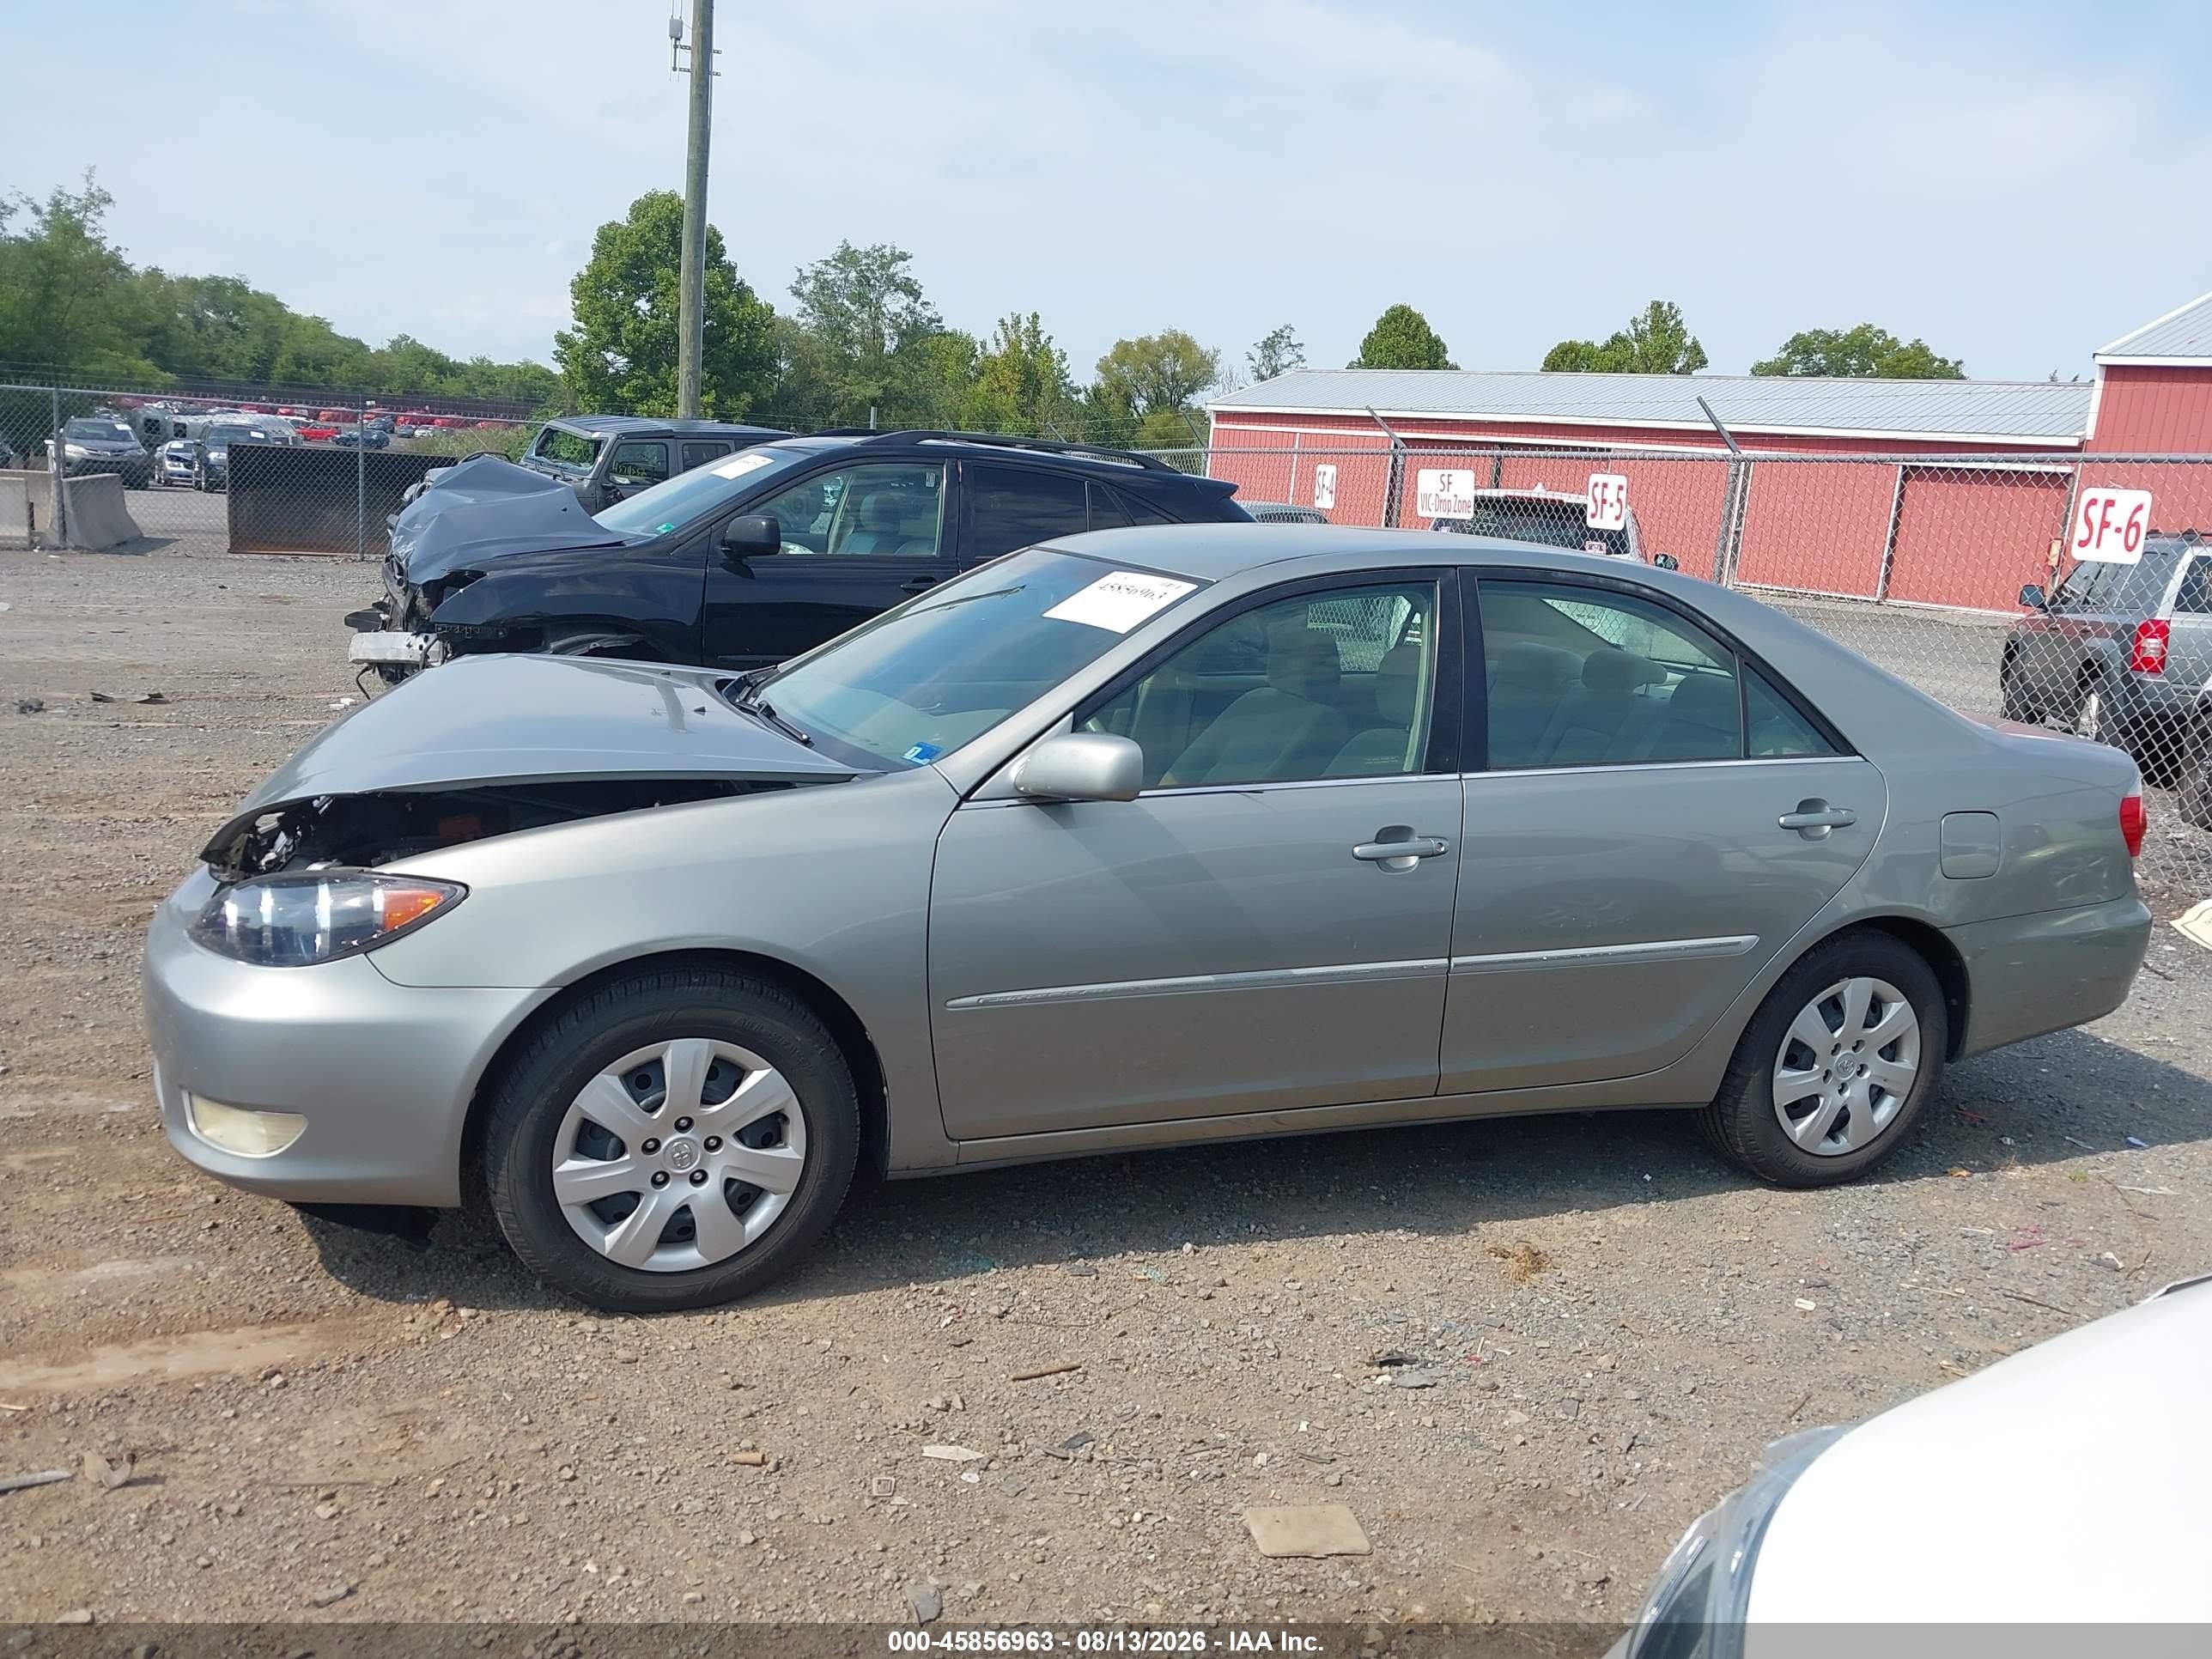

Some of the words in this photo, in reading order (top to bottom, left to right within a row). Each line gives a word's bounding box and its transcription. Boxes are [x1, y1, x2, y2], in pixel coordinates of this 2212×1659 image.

[1316, 471, 1334, 502] SF-4
[1439, 473, 1453, 493] SF
[1420, 493, 1452, 516] VIC-Drop
[1454, 494, 1472, 514] Zone
[1590, 482, 1625, 521] SF-5
[2077, 497, 2145, 552] SF-6
